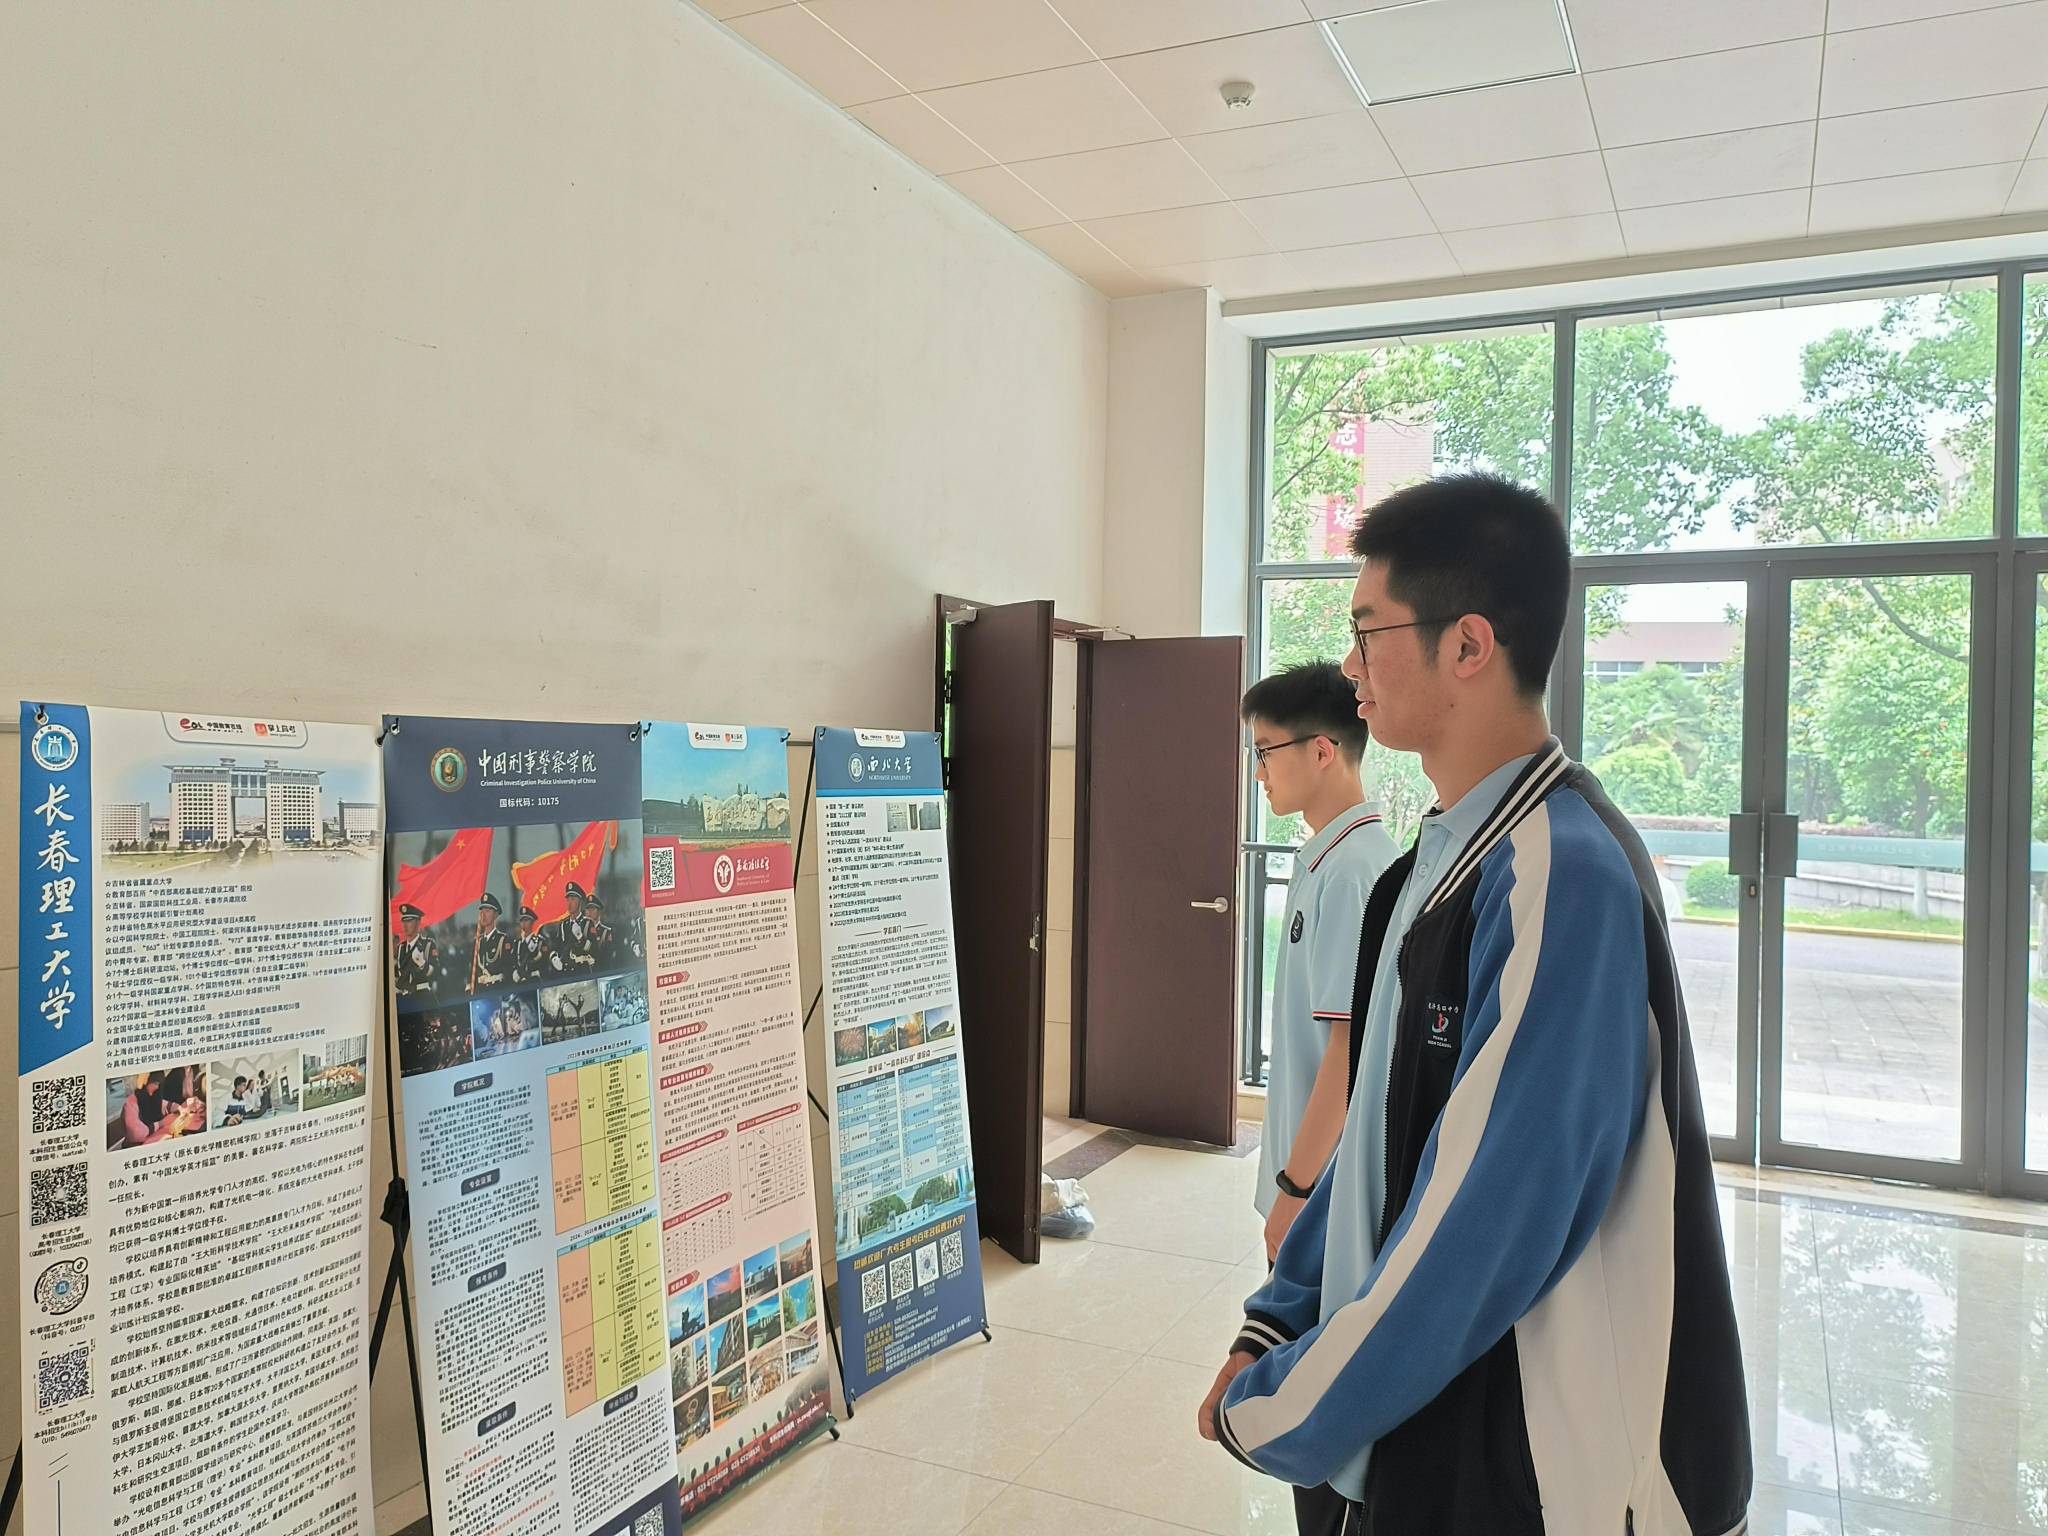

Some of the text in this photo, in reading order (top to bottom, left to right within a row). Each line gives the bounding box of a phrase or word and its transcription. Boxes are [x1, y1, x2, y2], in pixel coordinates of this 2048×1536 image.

[478, 749, 597, 777] 中国刑事警察学院
[868, 755, 911, 773] 西北大学
[504, 779, 537, 787] Investigation
[34, 782, 80, 1031] 长春理工大学
[108, 1188, 144, 1206] 一任院长。
